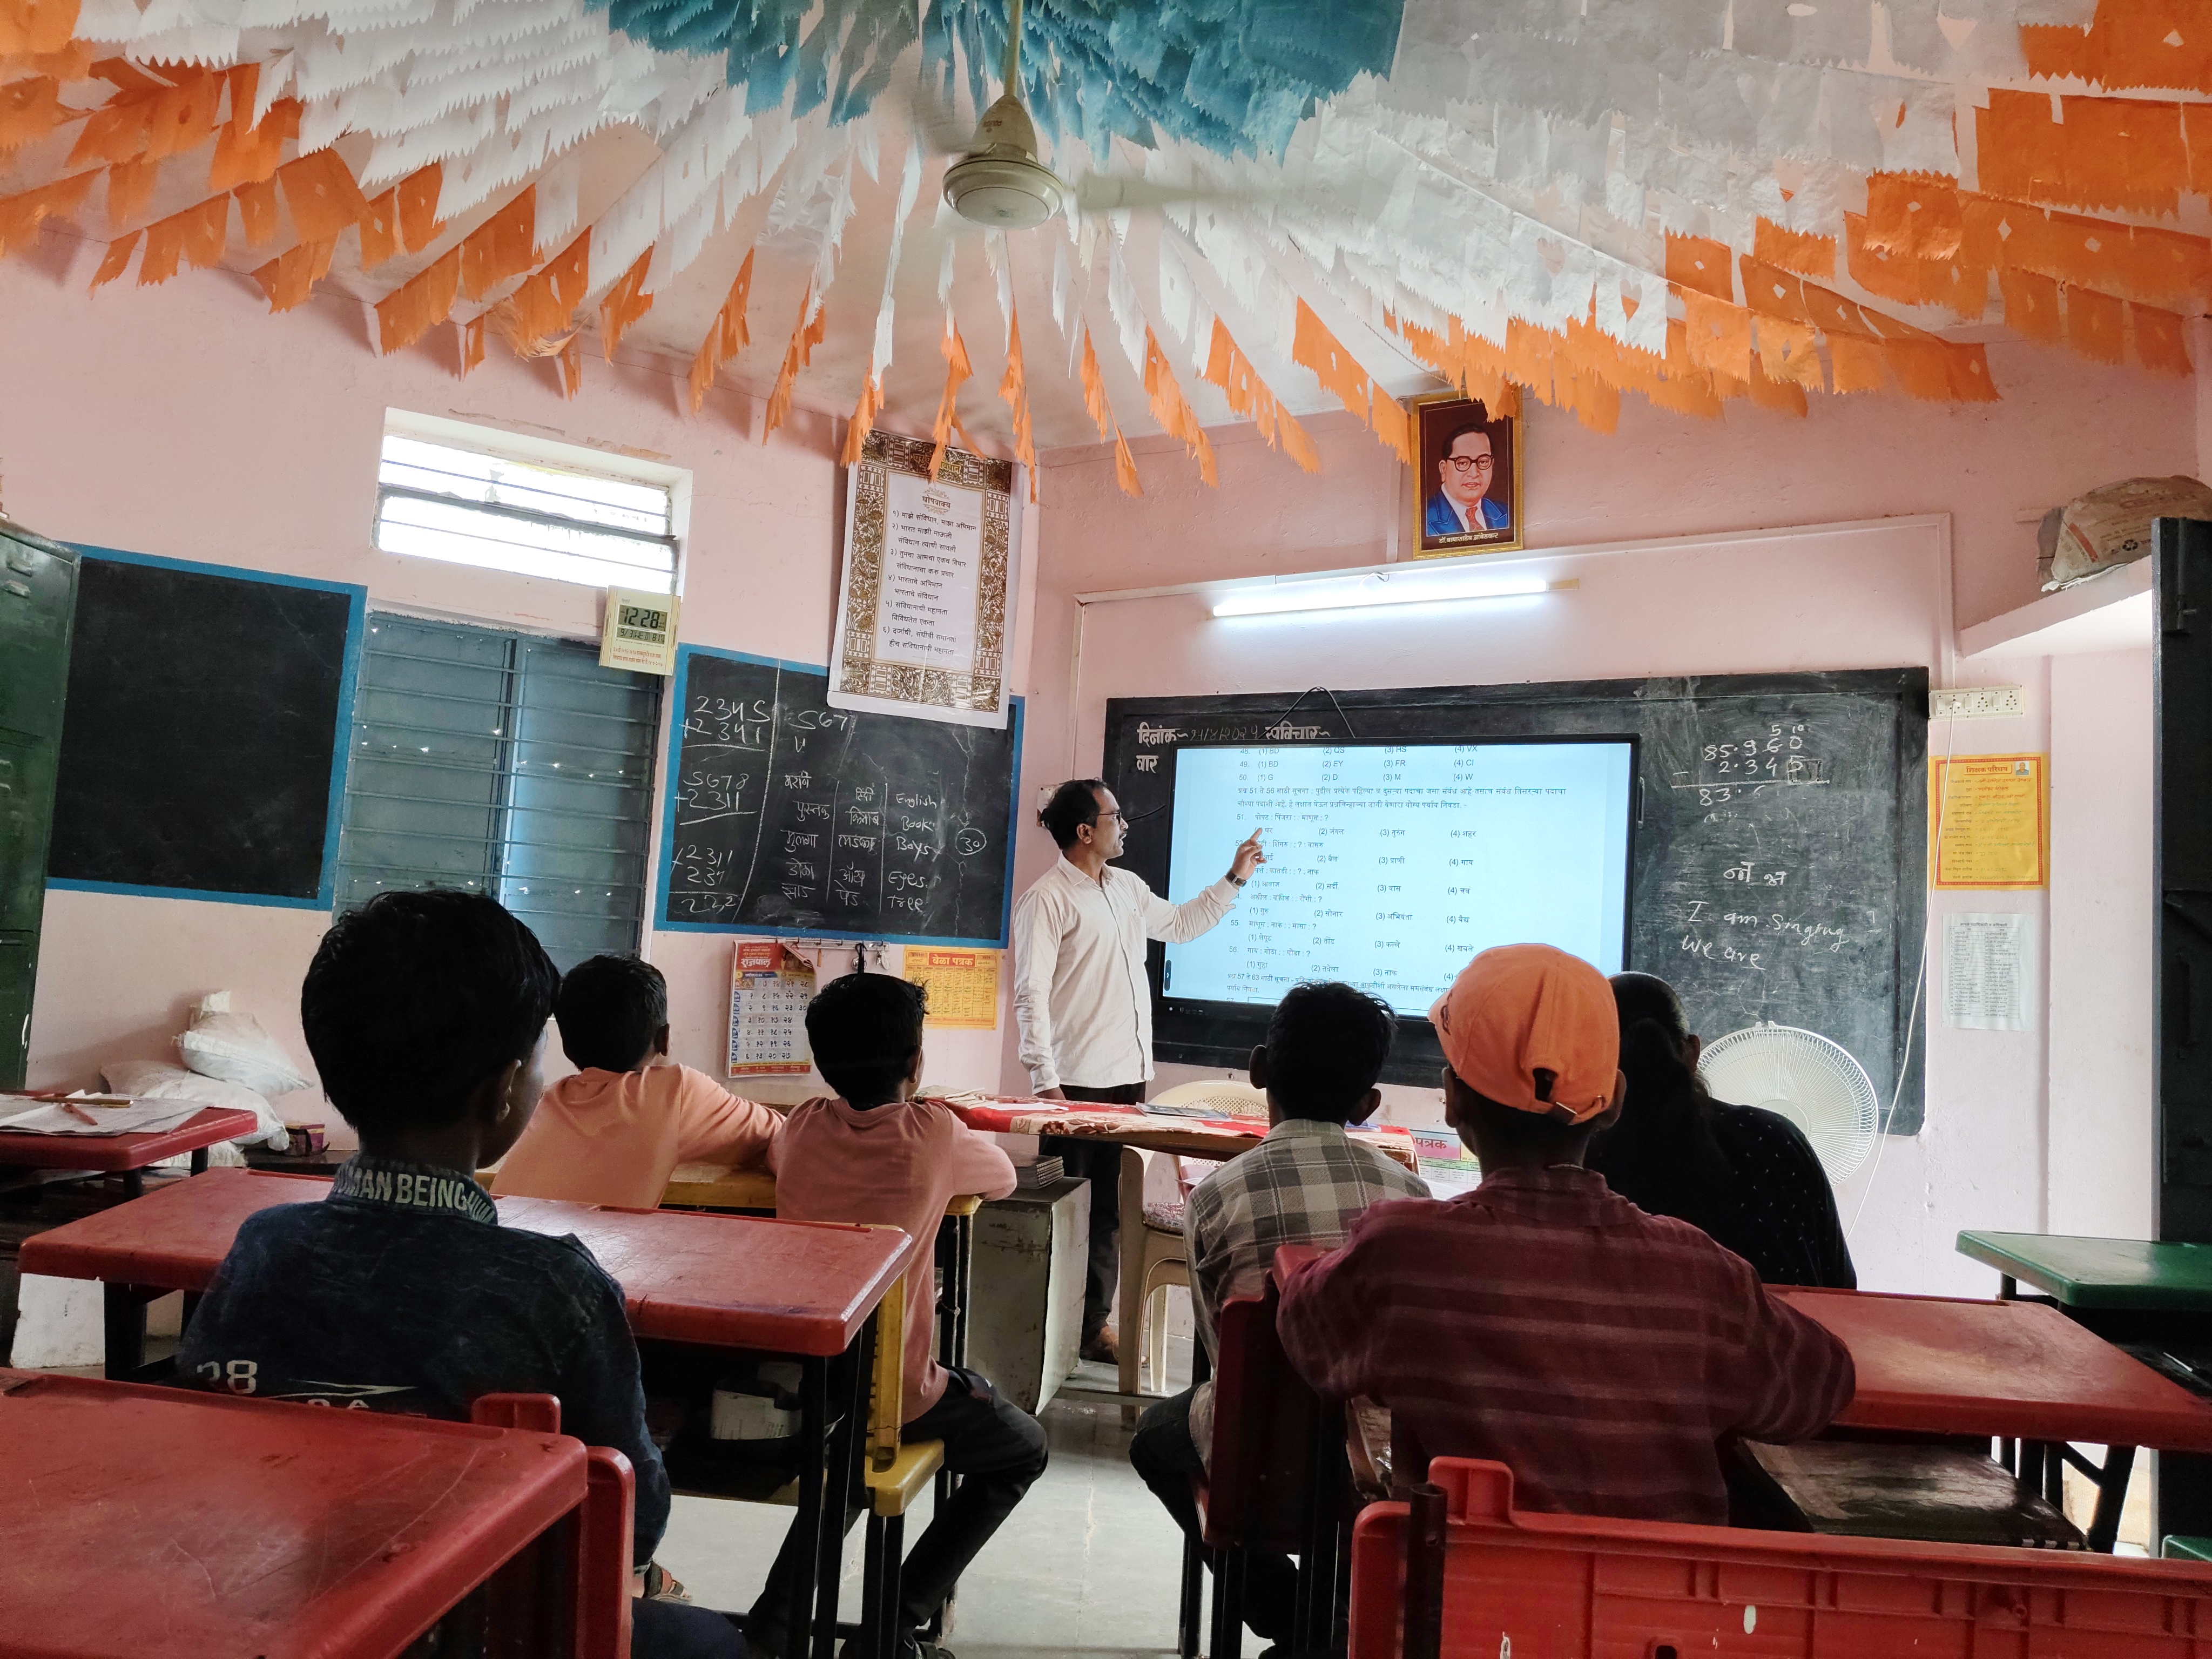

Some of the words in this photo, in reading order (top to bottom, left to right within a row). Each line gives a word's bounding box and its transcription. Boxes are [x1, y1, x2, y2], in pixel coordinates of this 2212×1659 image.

[922, 495, 950, 509] घोषवाक्य
[956, 522, 976, 531] अभिमान
[934, 530, 952, 539] माऊली
[898, 536, 919, 546] संविधान
[940, 544, 955, 552] सावली
[900, 550, 914, 558] तुमचा
[953, 559, 966, 568] विचार
[896, 562, 926, 574] संविधानाचा
[898, 576, 918, 585] भारताचे
[920, 579, 942, 589] अभिमान
[895, 588, 914, 597] भारताचे
[917, 591, 939, 601] संविधान
[895, 601, 925, 612] संविधानाची
[928, 607, 948, 616] महानता
[892, 613, 917, 623] विविधतेत
[936, 634, 956, 643] समानता
[889, 639, 900, 647] हीच
[902, 642, 932, 652] संविधानाची
[934, 647, 954, 655] महानता
[1137, 756, 1158, 773] वार
[1384, 760, 1393, 768] (3)
[1454, 759, 1463, 767] (4)
[1322, 774, 1330, 782] (2)
[1454, 773, 1462, 781] (4)
[1292, 788, 1309, 796] सूचना
[1316, 787, 1330, 795] पुढील
[1352, 786, 1373, 795] पहिल्या
[1460, 786, 1472, 795] आहे
[1496, 787, 1511, 795] संबंध
[896, 793, 937, 809] English
[1368, 800, 1382, 808] जागी
[1319, 828, 1327, 836] (2)
[1380, 829, 1389, 837] (3)
[1451, 830, 1460, 838] (4)
[1724, 913, 1758, 927] am
[1682, 935, 1718, 960] We
[1724, 947, 1766, 970] are
[932, 954, 950, 965] वेळा
[952, 957, 974, 966] पत्रक
[1415, 1137, 1447, 1149] पत्रक
[395, 1174, 467, 1210] BEING
